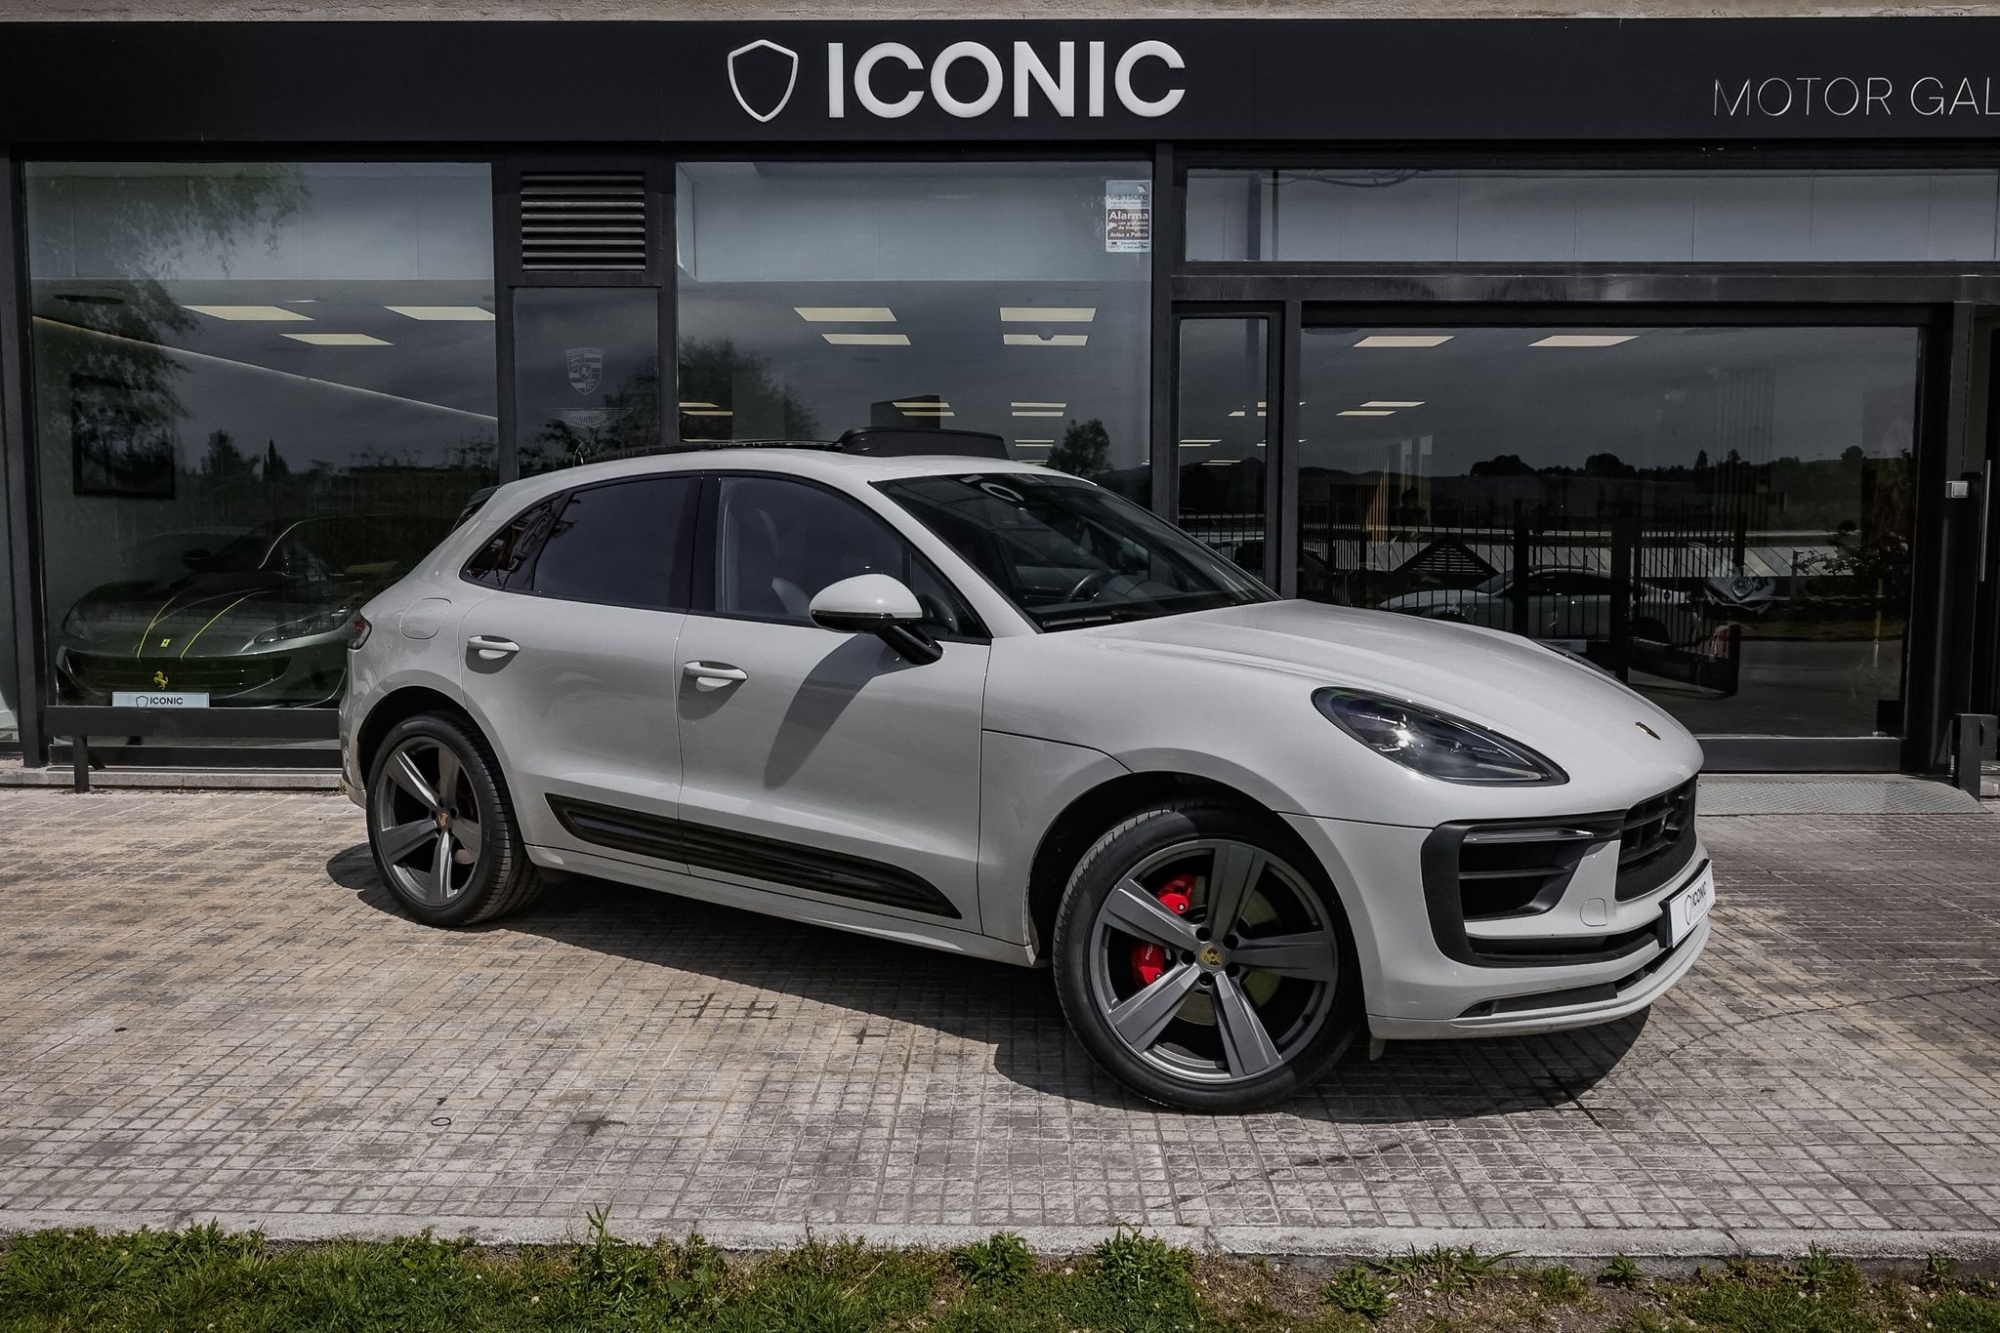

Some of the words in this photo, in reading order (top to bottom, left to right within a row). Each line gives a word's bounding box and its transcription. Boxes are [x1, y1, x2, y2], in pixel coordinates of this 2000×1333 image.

[828, 40, 1186, 118] ICONIC
[1713, 77, 1893, 116] MOTOR
[1109, 211, 1149, 220] Alarma
[149, 697, 184, 705] ICONIC
